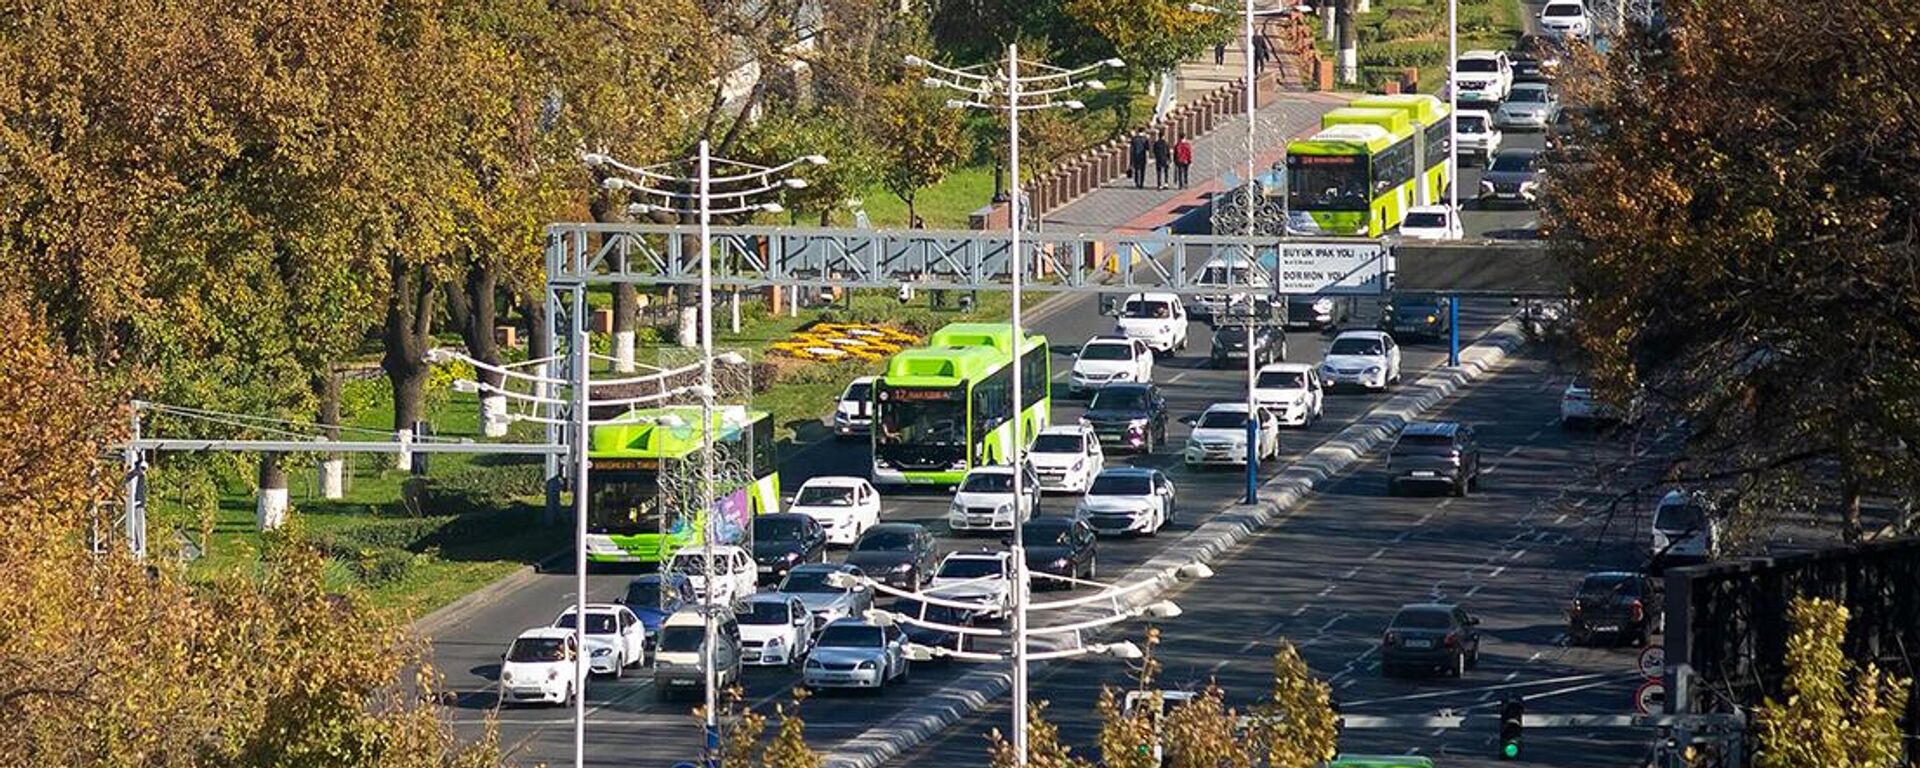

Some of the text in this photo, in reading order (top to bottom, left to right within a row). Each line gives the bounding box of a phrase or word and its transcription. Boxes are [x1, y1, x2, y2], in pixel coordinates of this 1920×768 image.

[1283, 249, 1313, 257] BUYUK
[1315, 249, 1334, 257] IPAK
[1283, 271, 1323, 280] DORMON
